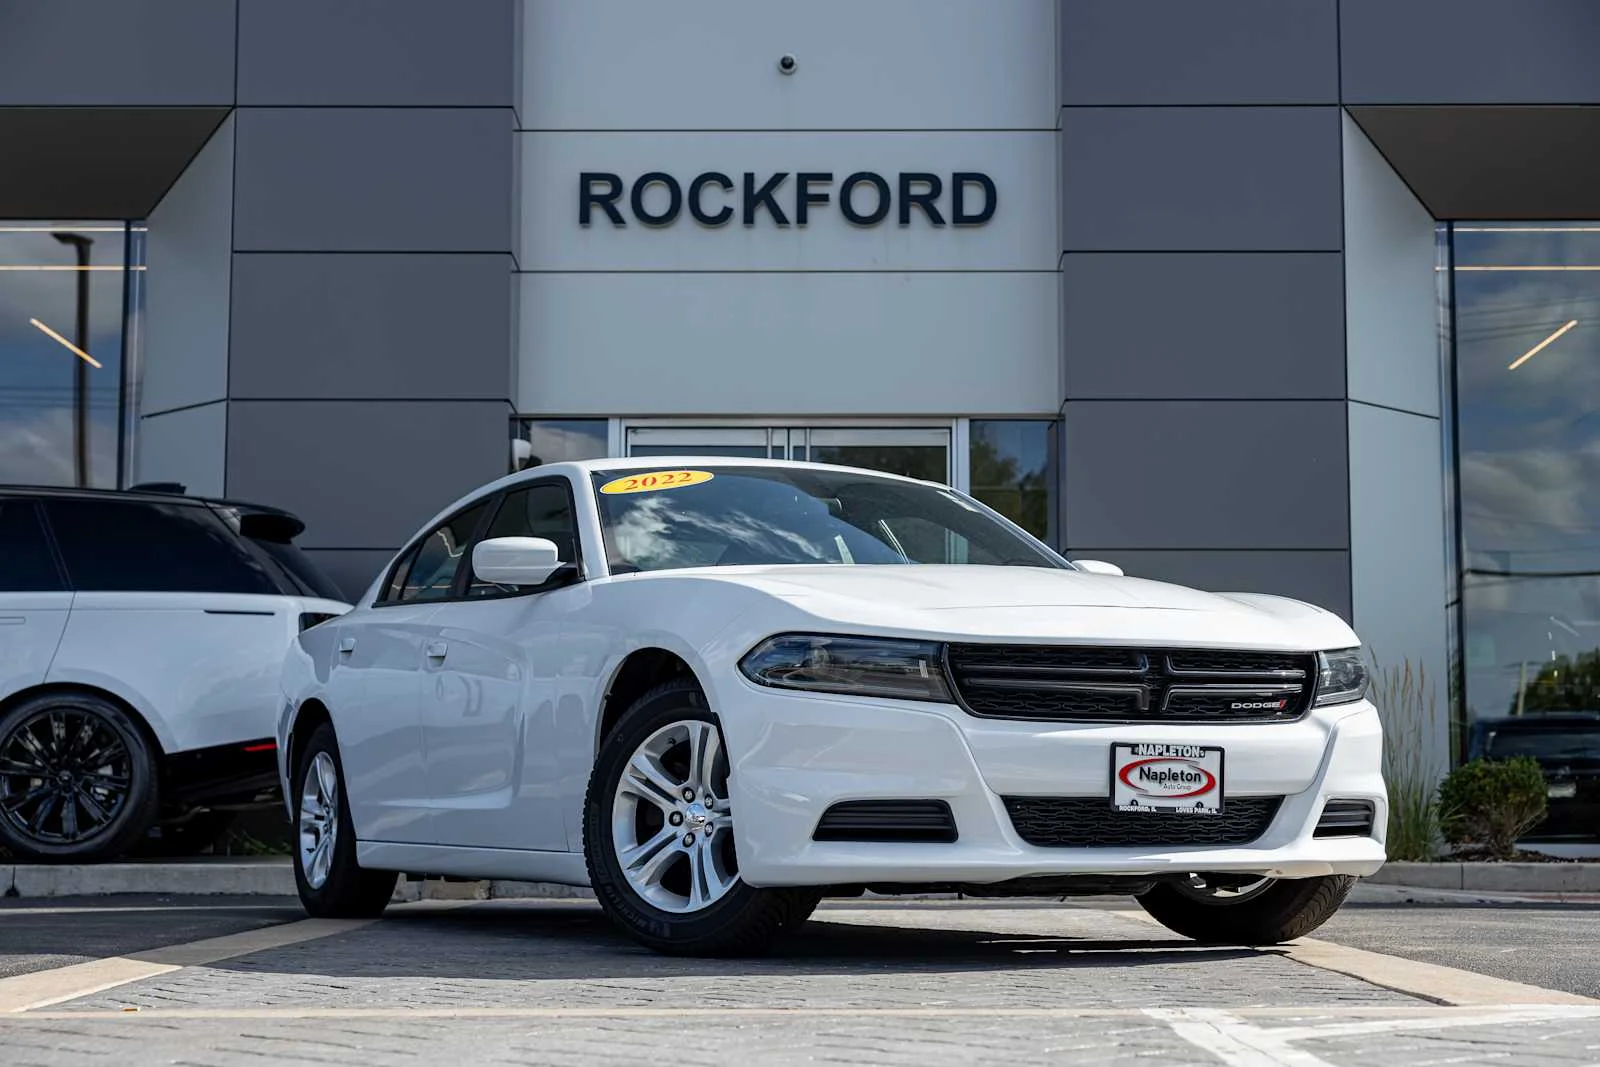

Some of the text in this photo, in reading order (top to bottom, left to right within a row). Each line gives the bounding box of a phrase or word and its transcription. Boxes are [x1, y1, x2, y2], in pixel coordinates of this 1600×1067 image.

[579, 171, 998, 227] ROCKFORD
[624, 472, 692, 490] 2022
[1231, 701, 1280, 709] DODGE
[1139, 744, 1200, 758] NAPLETON
[1139, 766, 1201, 784] Napleton
